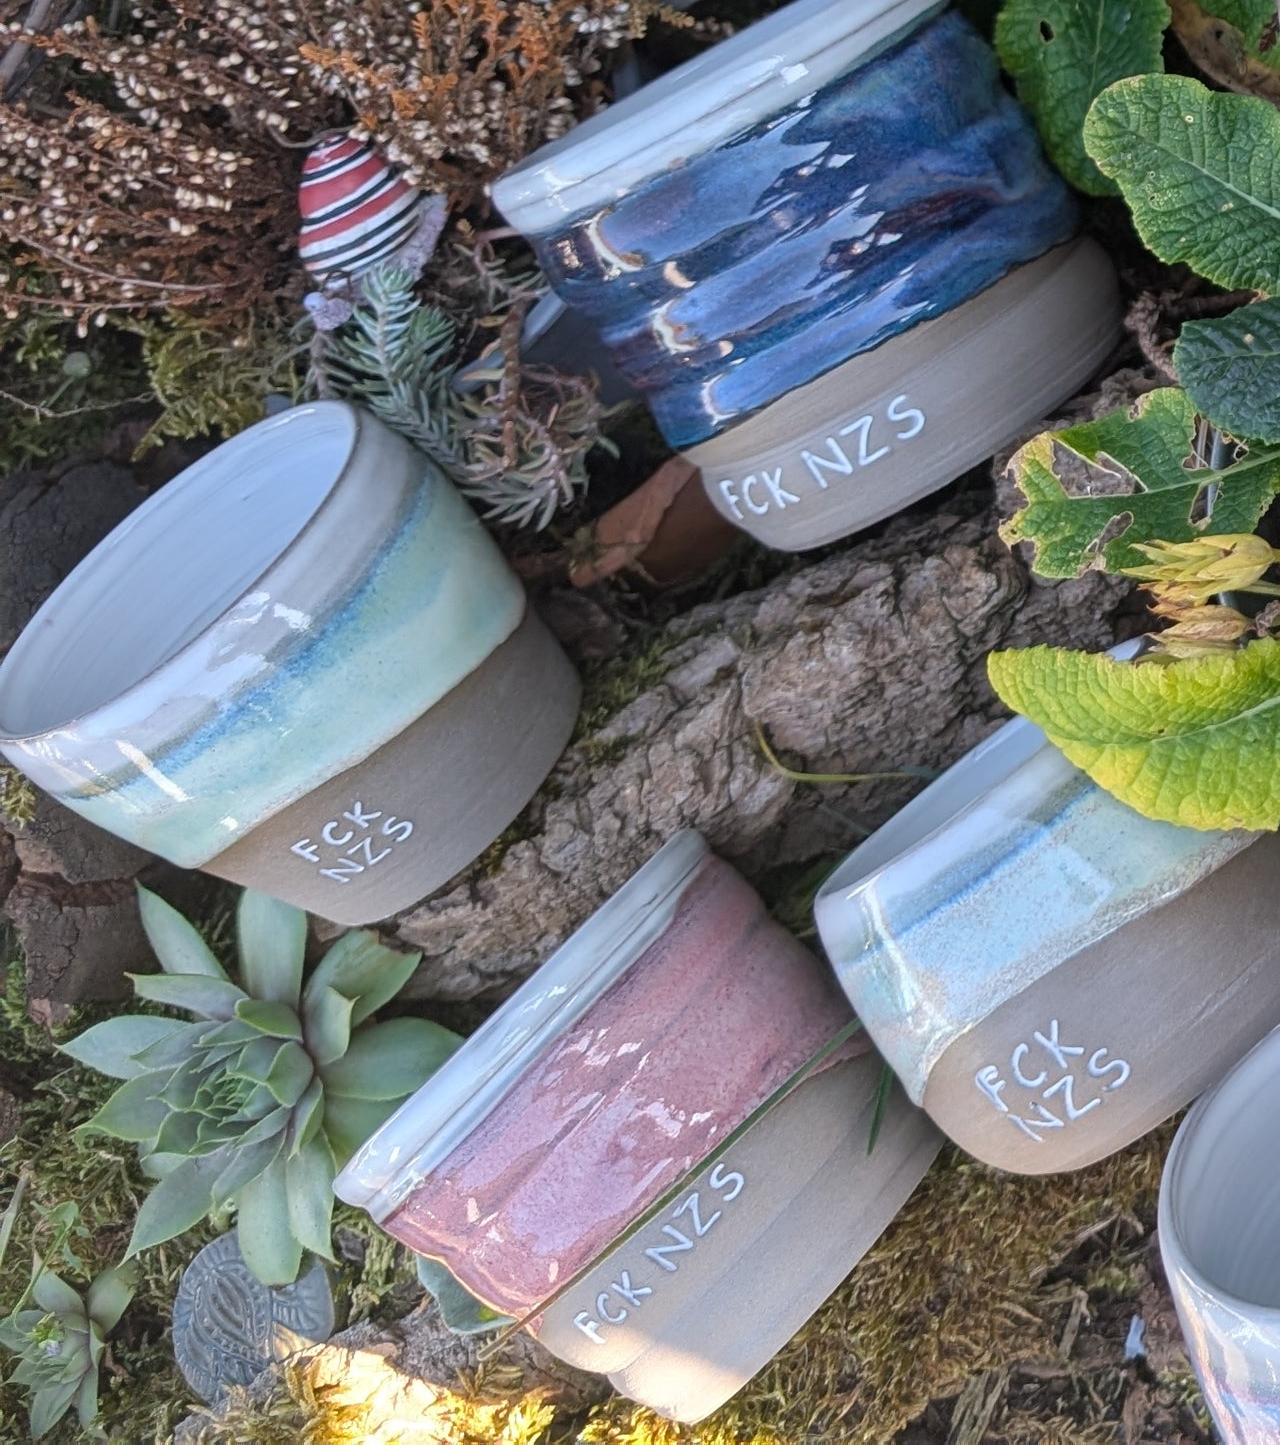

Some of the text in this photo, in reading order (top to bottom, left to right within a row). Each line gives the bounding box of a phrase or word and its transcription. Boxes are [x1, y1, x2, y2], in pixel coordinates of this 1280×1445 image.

[718, 394, 927, 520] FCK NZS
[290, 800, 383, 862] FCK
[319, 815, 414, 884] NZS
[974, 1018, 1085, 1112] FCK
[1007, 1047, 1131, 1142] NZS
[574, 1162, 746, 1344] FCK NZS
